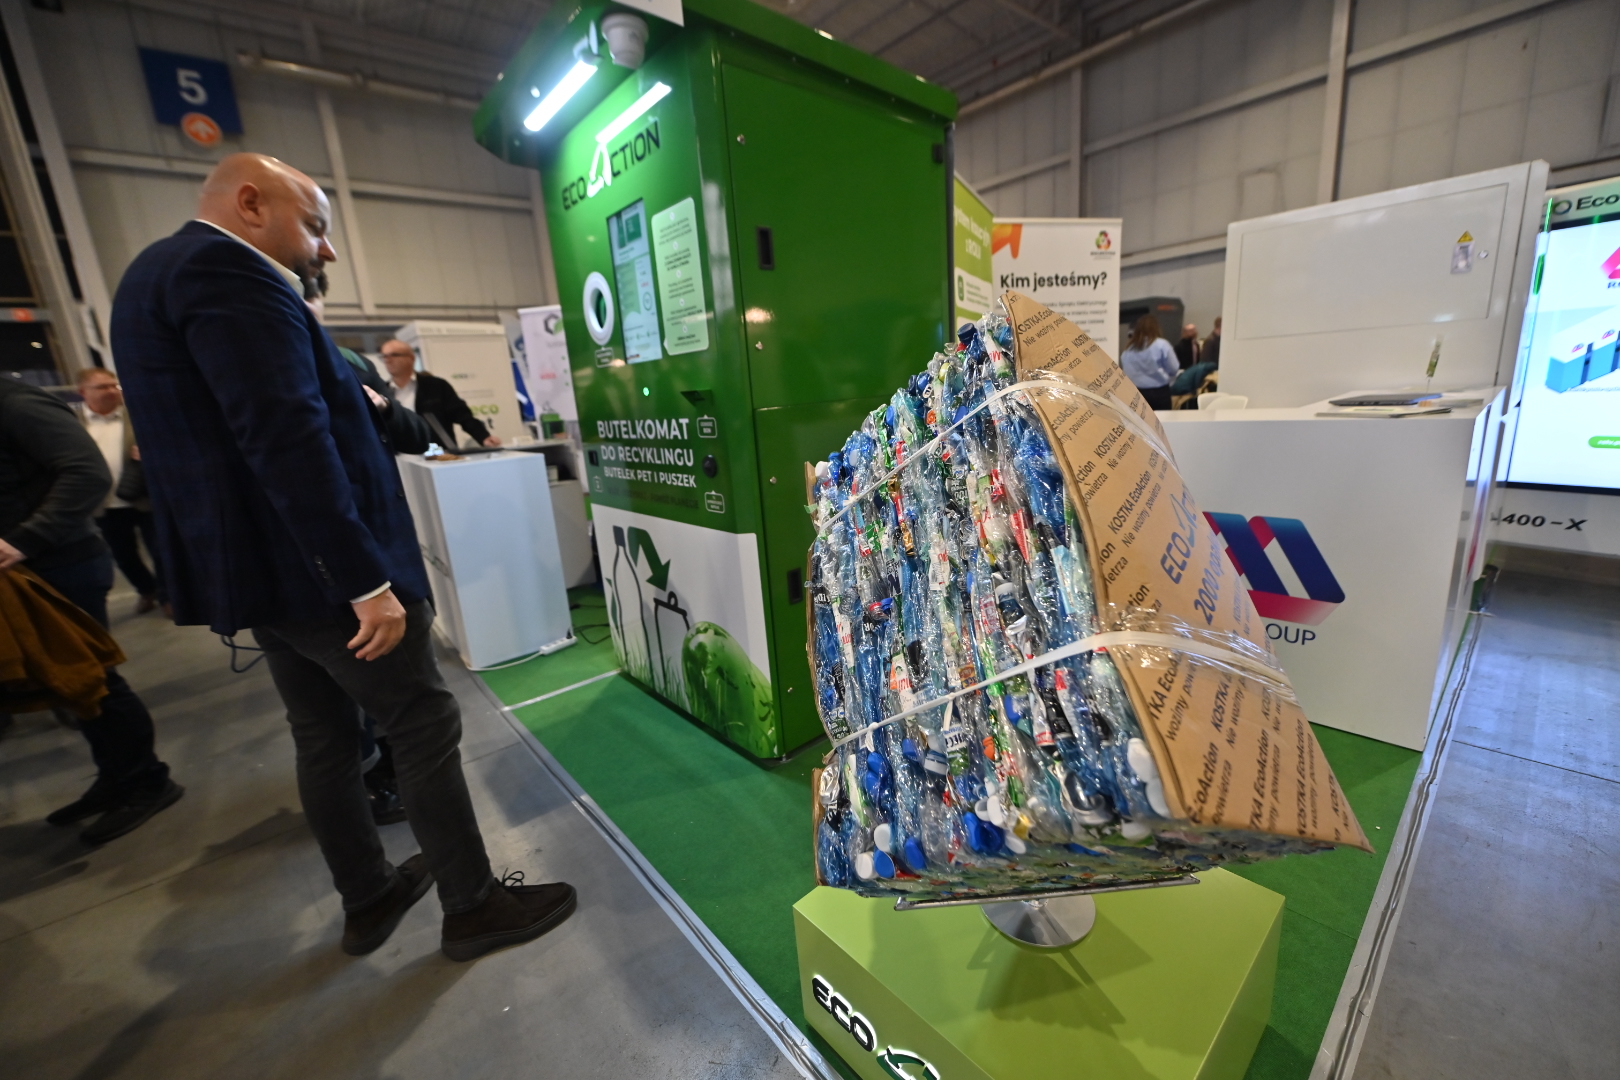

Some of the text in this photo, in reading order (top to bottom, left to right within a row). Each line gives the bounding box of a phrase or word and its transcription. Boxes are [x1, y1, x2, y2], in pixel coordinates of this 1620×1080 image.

[177, 68, 207, 105] 5
[1000, 271, 1108, 292] Kim jesteśmy?
[1023, 336, 1037, 347] Nie
[597, 418, 689, 440] BUTELKOMAT
[1069, 410, 1094, 435] powietrza
[600, 445, 694, 467] DO RECYKLINGU
[1094, 430, 1119, 459] KOSTKA
[604, 466, 697, 488] BUTELEK PET I PUSZEK
[1106, 459, 1119, 471] Nie
[1107, 498, 1137, 535] KOSTKA
[1132, 470, 1152, 504] EcoAction
[1121, 530, 1136, 547] Nie
[1132, 509, 1151, 533] wozimy
[1194, 569, 1220, 625] 2000
[1265, 623, 1316, 645] OUP
[1165, 695, 1189, 741] wozimy
[1210, 680, 1231, 734] KOSTKA
[1225, 727, 1237, 749] Nie
[1254, 729, 1270, 799] EcoAction
